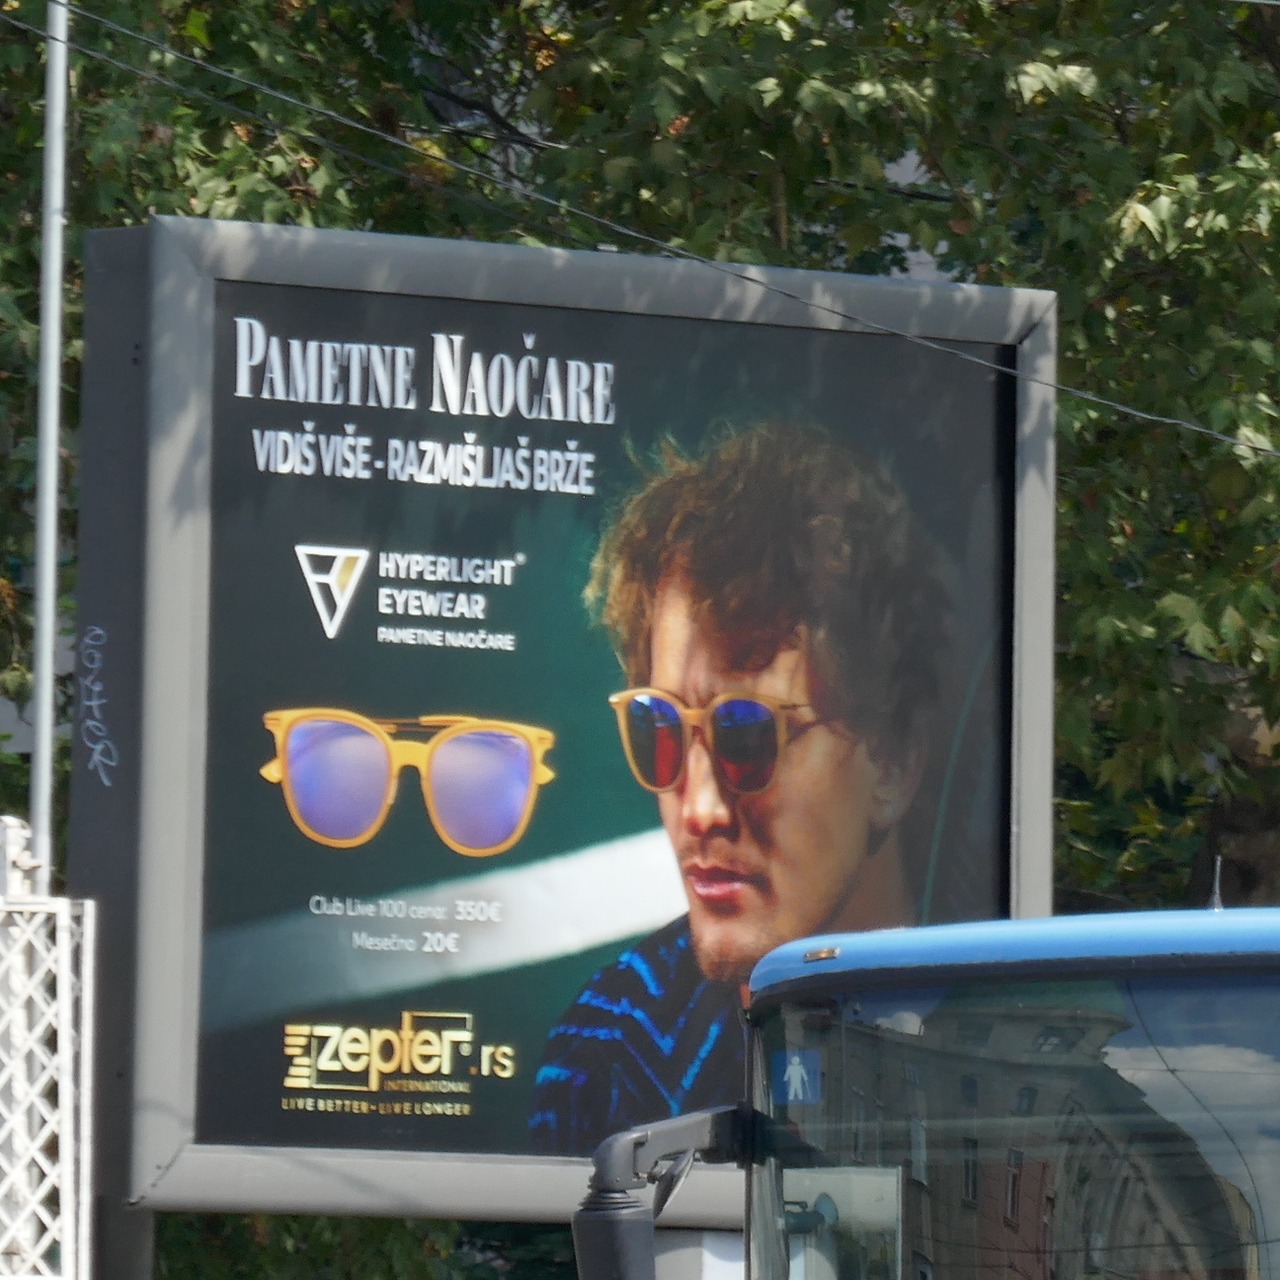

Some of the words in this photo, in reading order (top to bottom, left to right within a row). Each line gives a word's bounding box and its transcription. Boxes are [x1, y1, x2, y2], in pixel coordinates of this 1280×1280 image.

[252, 421, 316, 475] VIDIŠ
[318, 424, 373, 479] VIŠE
[388, 432, 529, 491] RAZMIŠLJAŠ
[535, 440, 596, 495] BRŽE
[377, 587, 487, 620] EYEWEAR
[377, 626, 444, 647] PAMETNE
[309, 895, 344, 916] Club
[378, 899, 406, 919] 100
[421, 932, 460, 952] 20€
[281, 1097, 315, 1111] LIVE
[378, 1102, 412, 1115] LIVE
